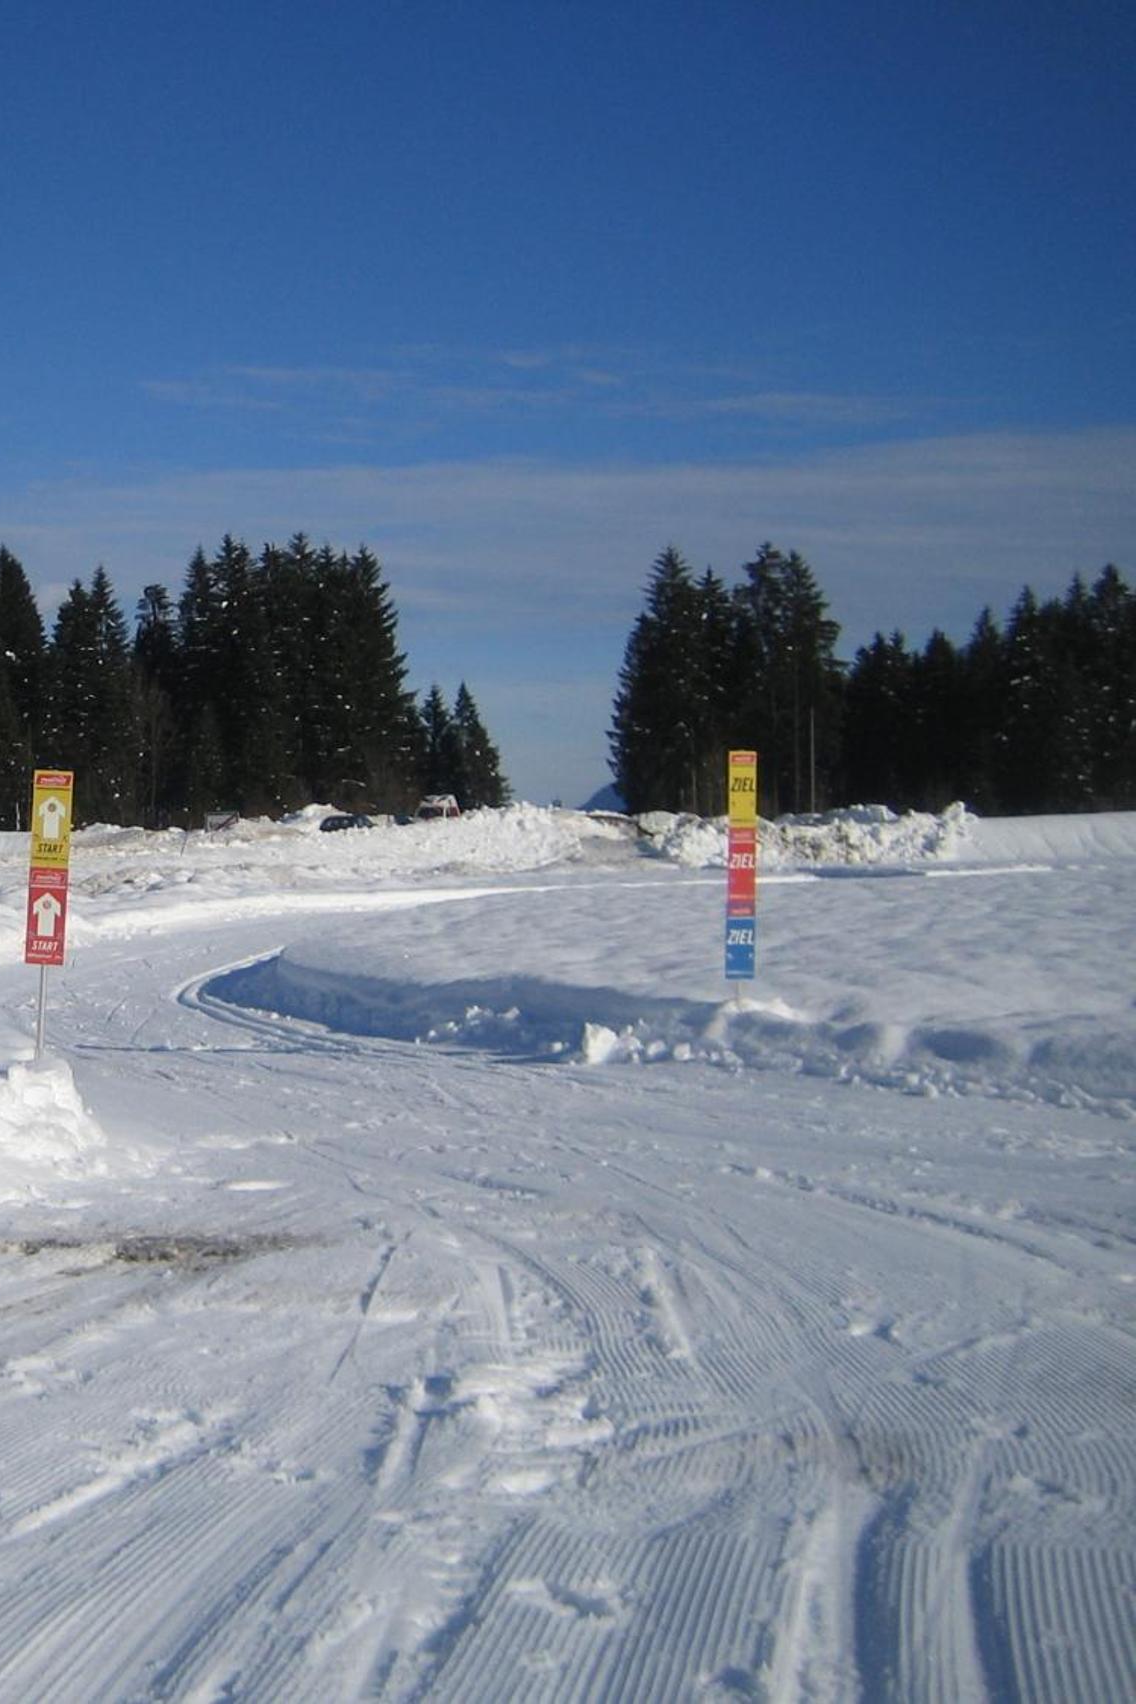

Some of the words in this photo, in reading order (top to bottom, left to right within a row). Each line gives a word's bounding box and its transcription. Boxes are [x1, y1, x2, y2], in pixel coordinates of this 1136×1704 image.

[731, 777, 755, 793] ZIEL
[38, 842, 64, 854] START
[729, 853, 755, 869] ZIEL
[727, 929, 755, 946] ZIEL
[31, 940, 58, 952] START
